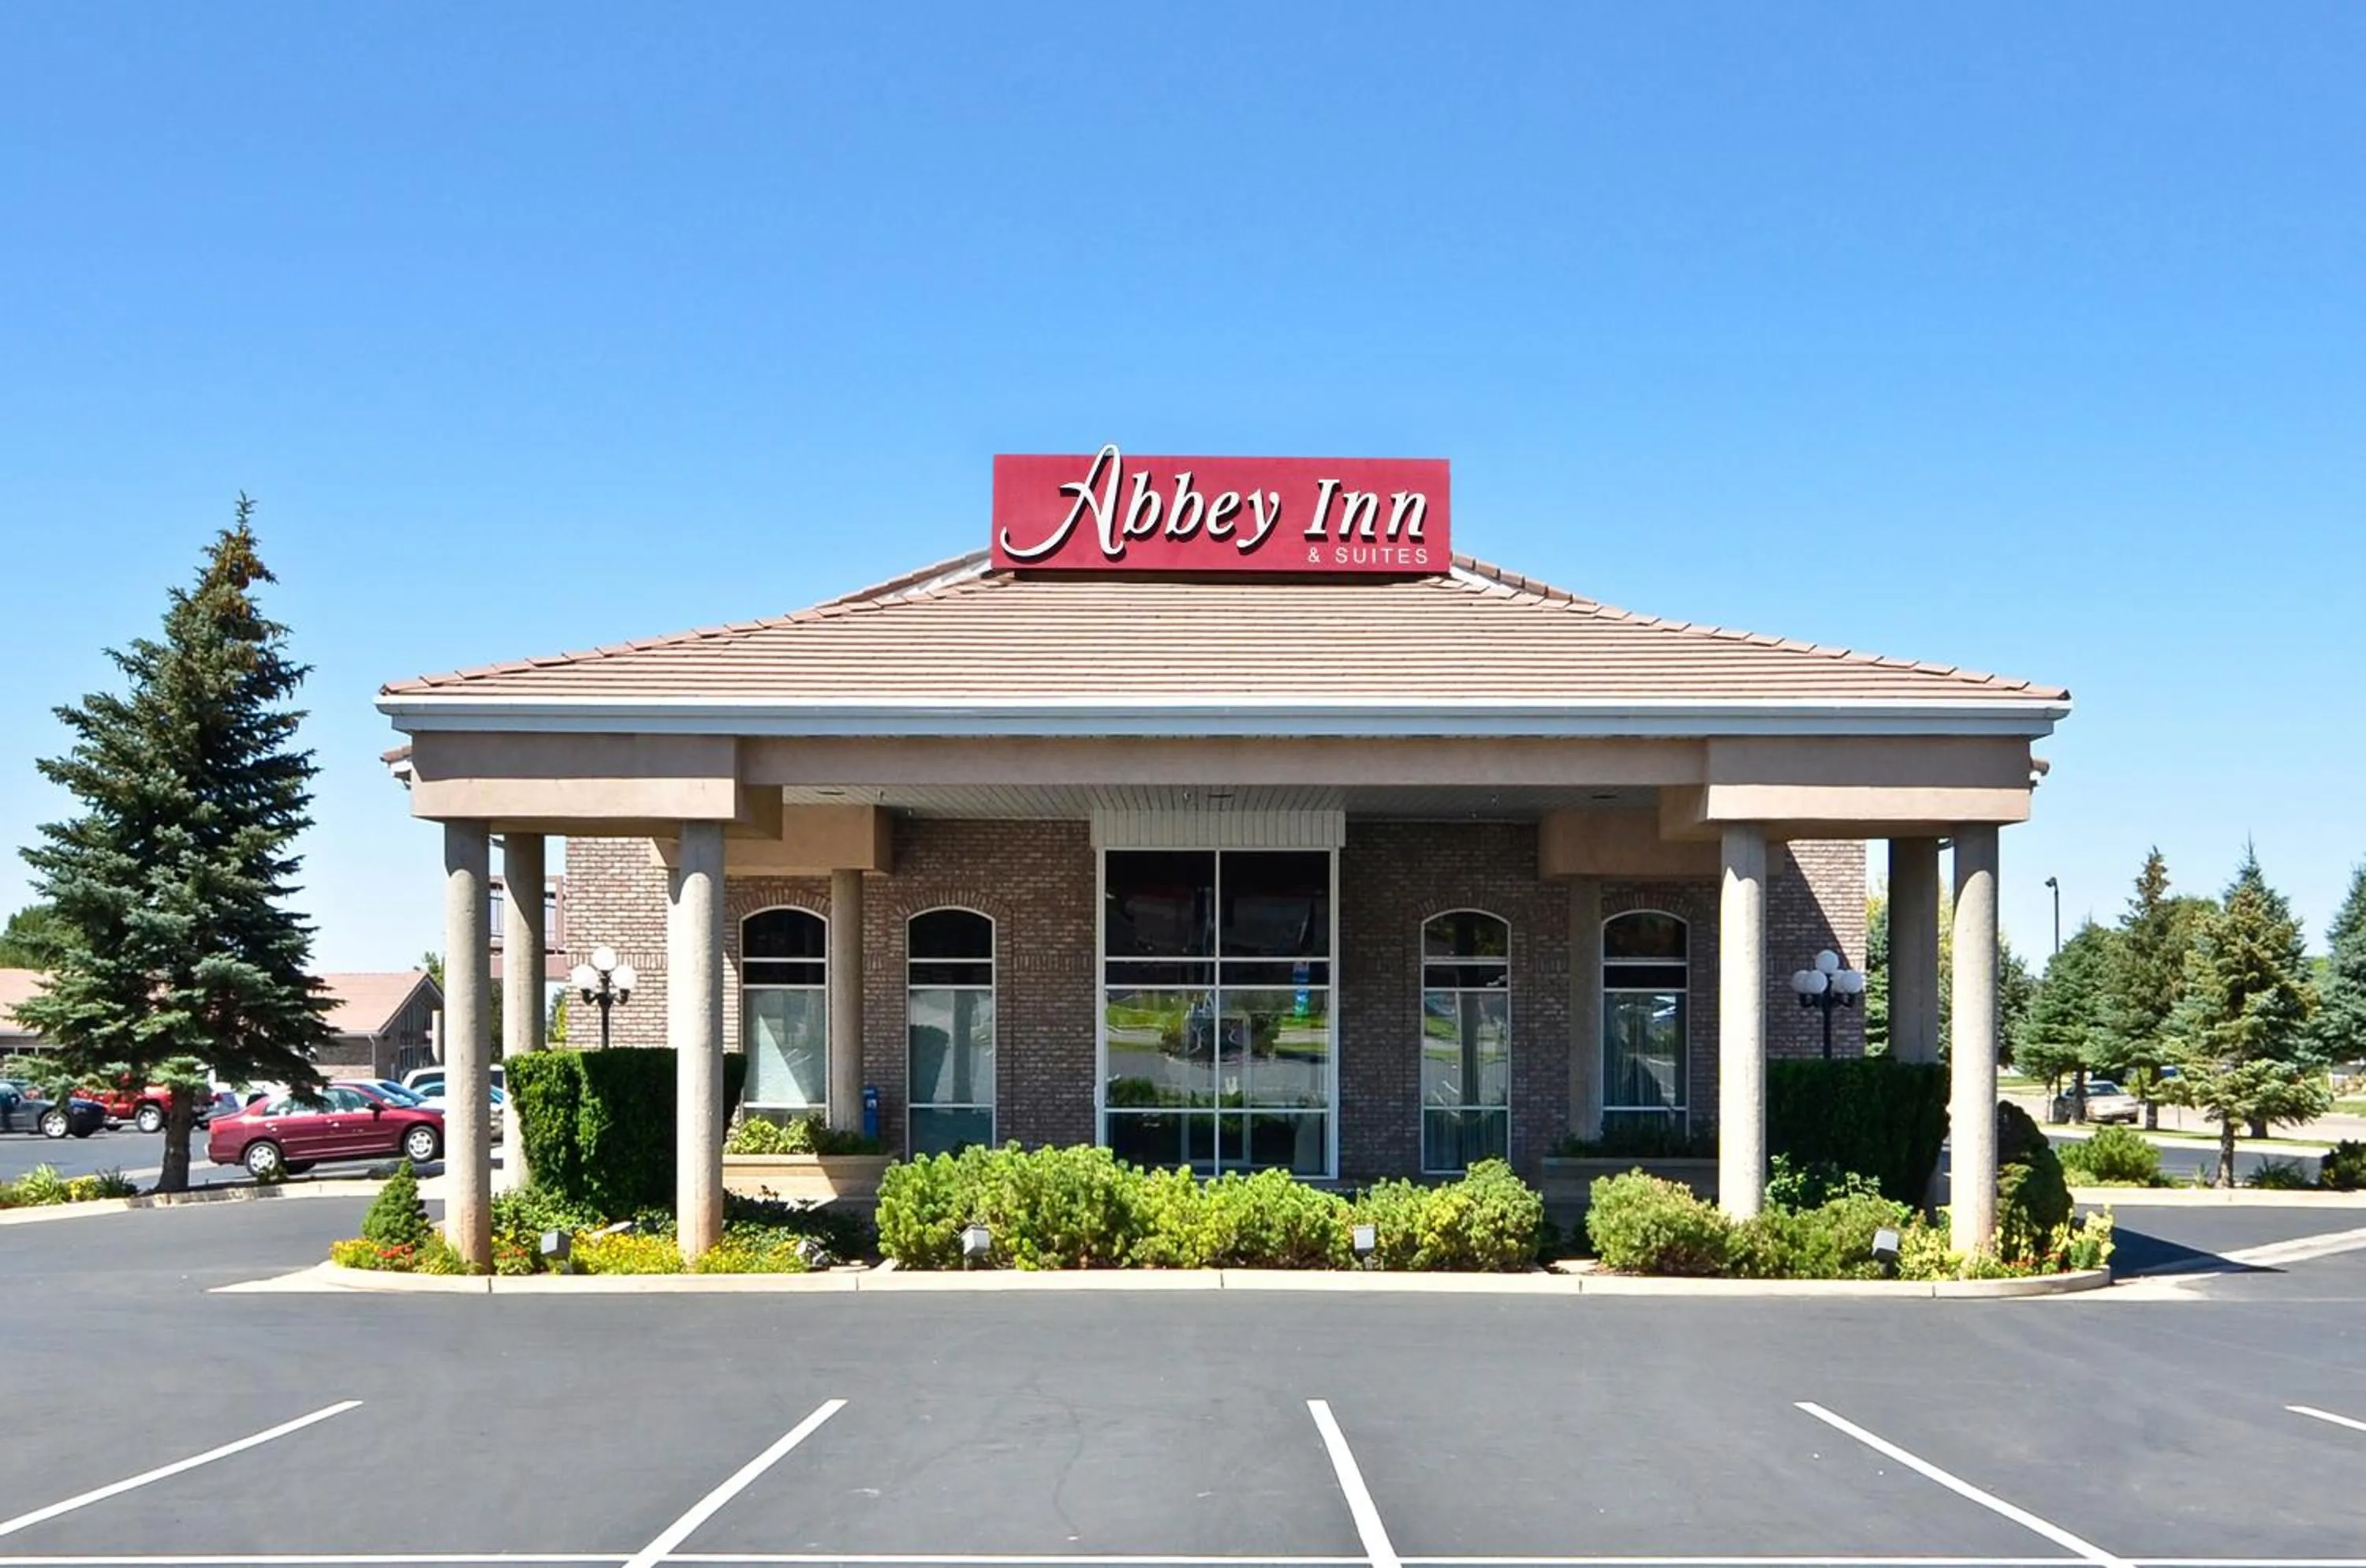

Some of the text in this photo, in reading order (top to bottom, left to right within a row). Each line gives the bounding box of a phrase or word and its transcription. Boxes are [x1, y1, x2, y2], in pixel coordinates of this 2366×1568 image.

[999, 444, 1427, 557] Abbey Inn
[1308, 547, 1428, 564] & SUITES
